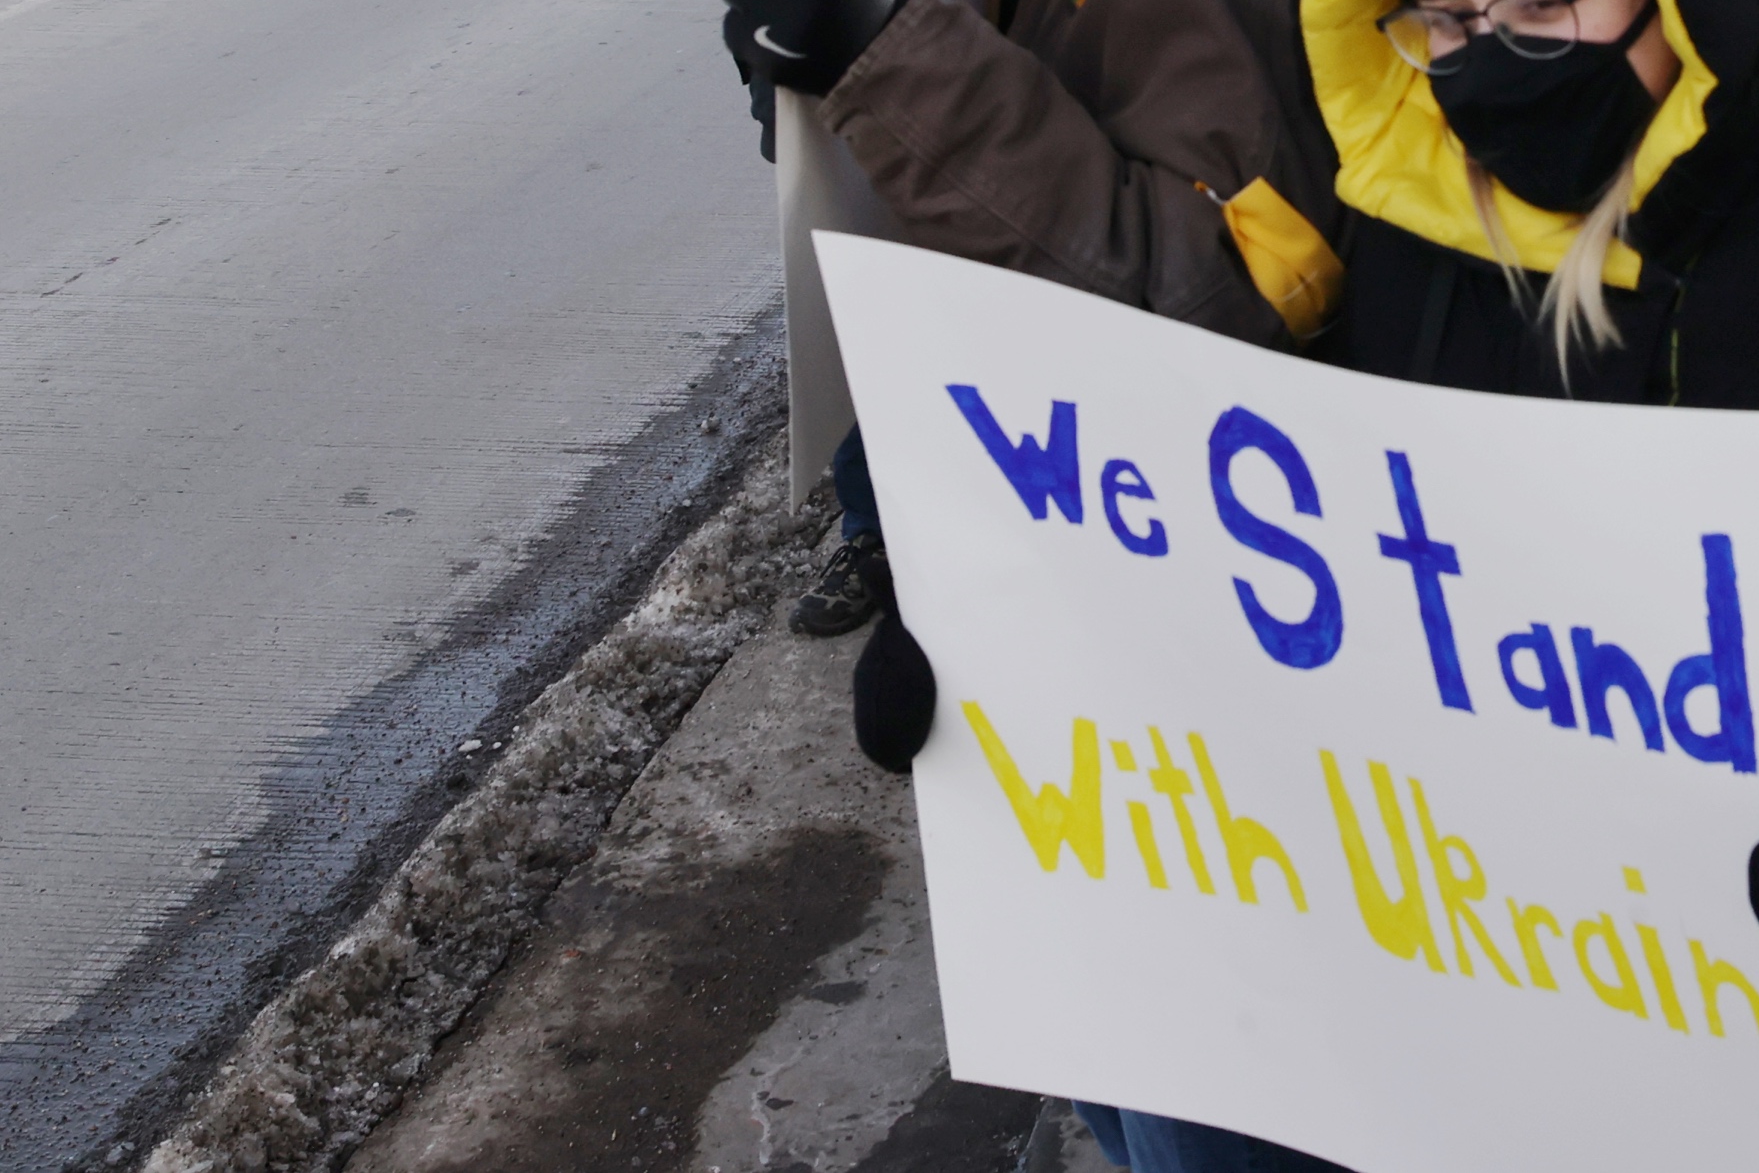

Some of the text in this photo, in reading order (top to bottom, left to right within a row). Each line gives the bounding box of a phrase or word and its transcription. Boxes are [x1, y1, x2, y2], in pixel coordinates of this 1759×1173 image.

[947, 385, 1756, 773] We Stand
[962, 702, 1307, 912] With
